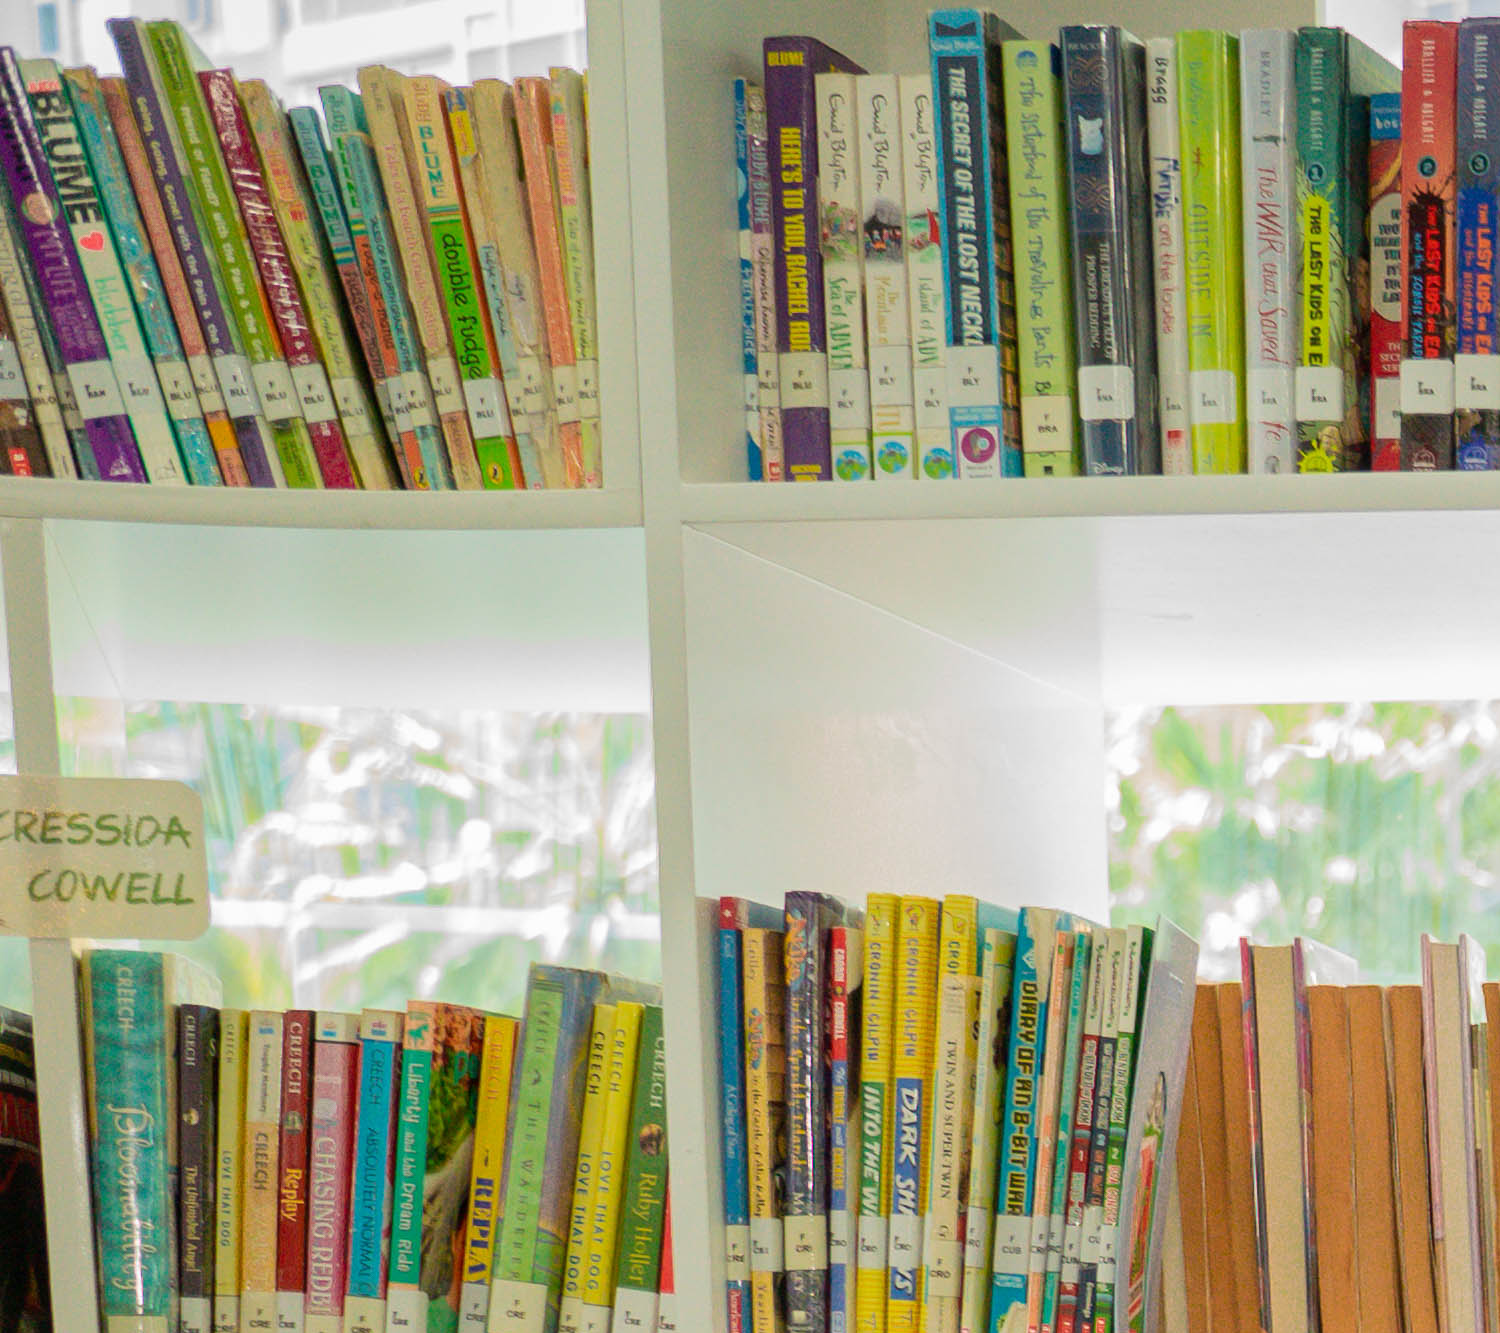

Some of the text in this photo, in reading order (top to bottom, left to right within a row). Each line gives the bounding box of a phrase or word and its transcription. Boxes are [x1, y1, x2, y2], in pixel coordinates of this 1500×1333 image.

[33, 92, 99, 225] BLUME
[949, 67, 977, 279] THE SECRET OF THE LOST
[442, 233, 484, 381] double fudge
[28, 870, 195, 905] COWELL
[1018, 981, 1039, 1042] DIARY
[1017, 1044, 1035, 1072] OF
[1015, 1074, 1031, 1105] AN
[899, 1089, 920, 1166] DARK
[1012, 1111, 1031, 1169] 8-BIT
[283, 1169, 301, 1224] Replay
[626, 1173, 656, 1287] Ruby Holler
